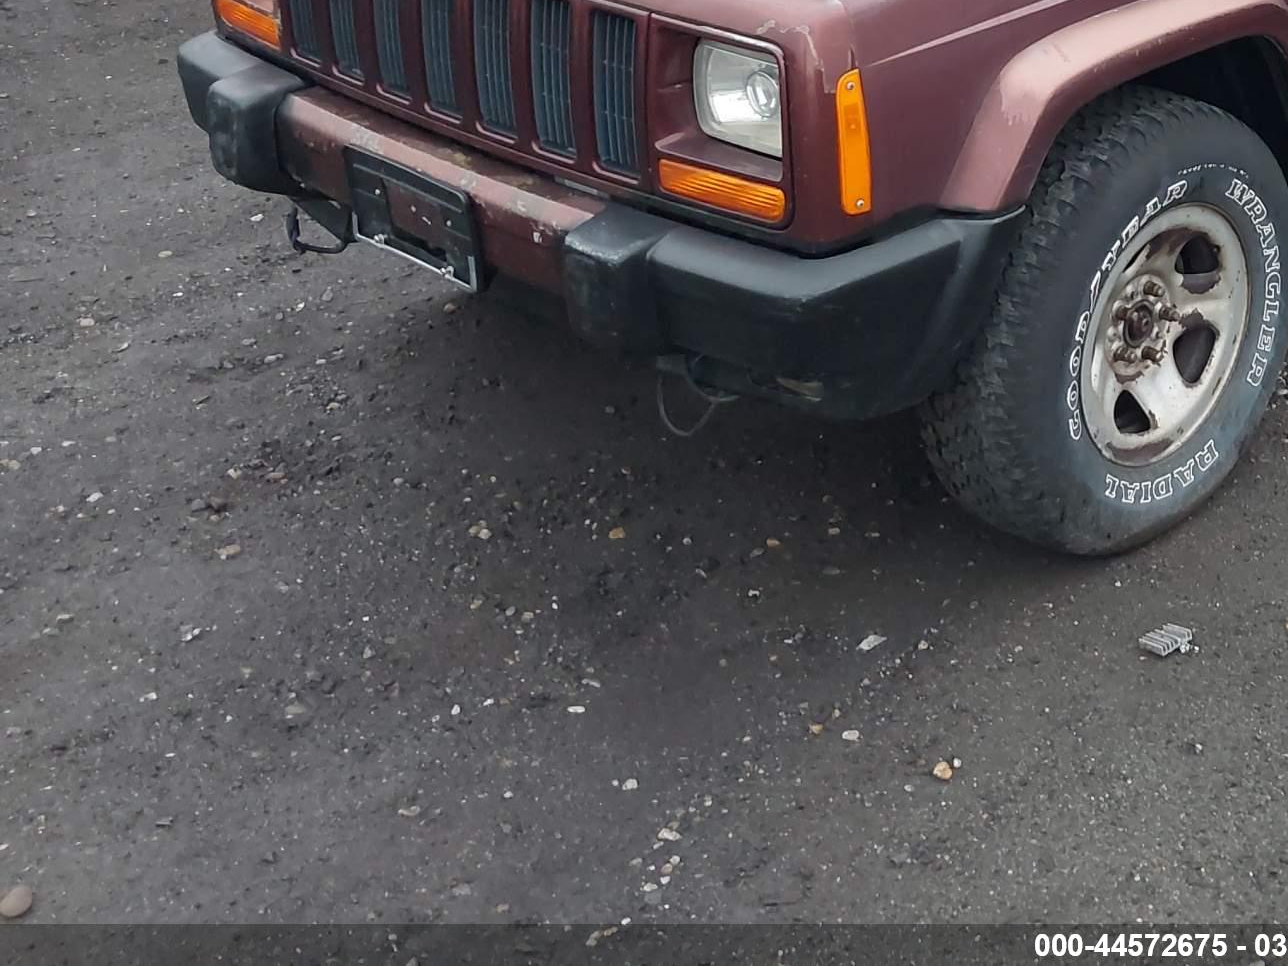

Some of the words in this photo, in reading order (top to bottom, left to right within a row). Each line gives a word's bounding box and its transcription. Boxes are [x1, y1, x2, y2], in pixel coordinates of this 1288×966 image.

[1066, 179, 1190, 442] GOODYEAR
[1224, 178, 1283, 387] WRANGLER
[1104, 439, 1219, 504] RADIAL
